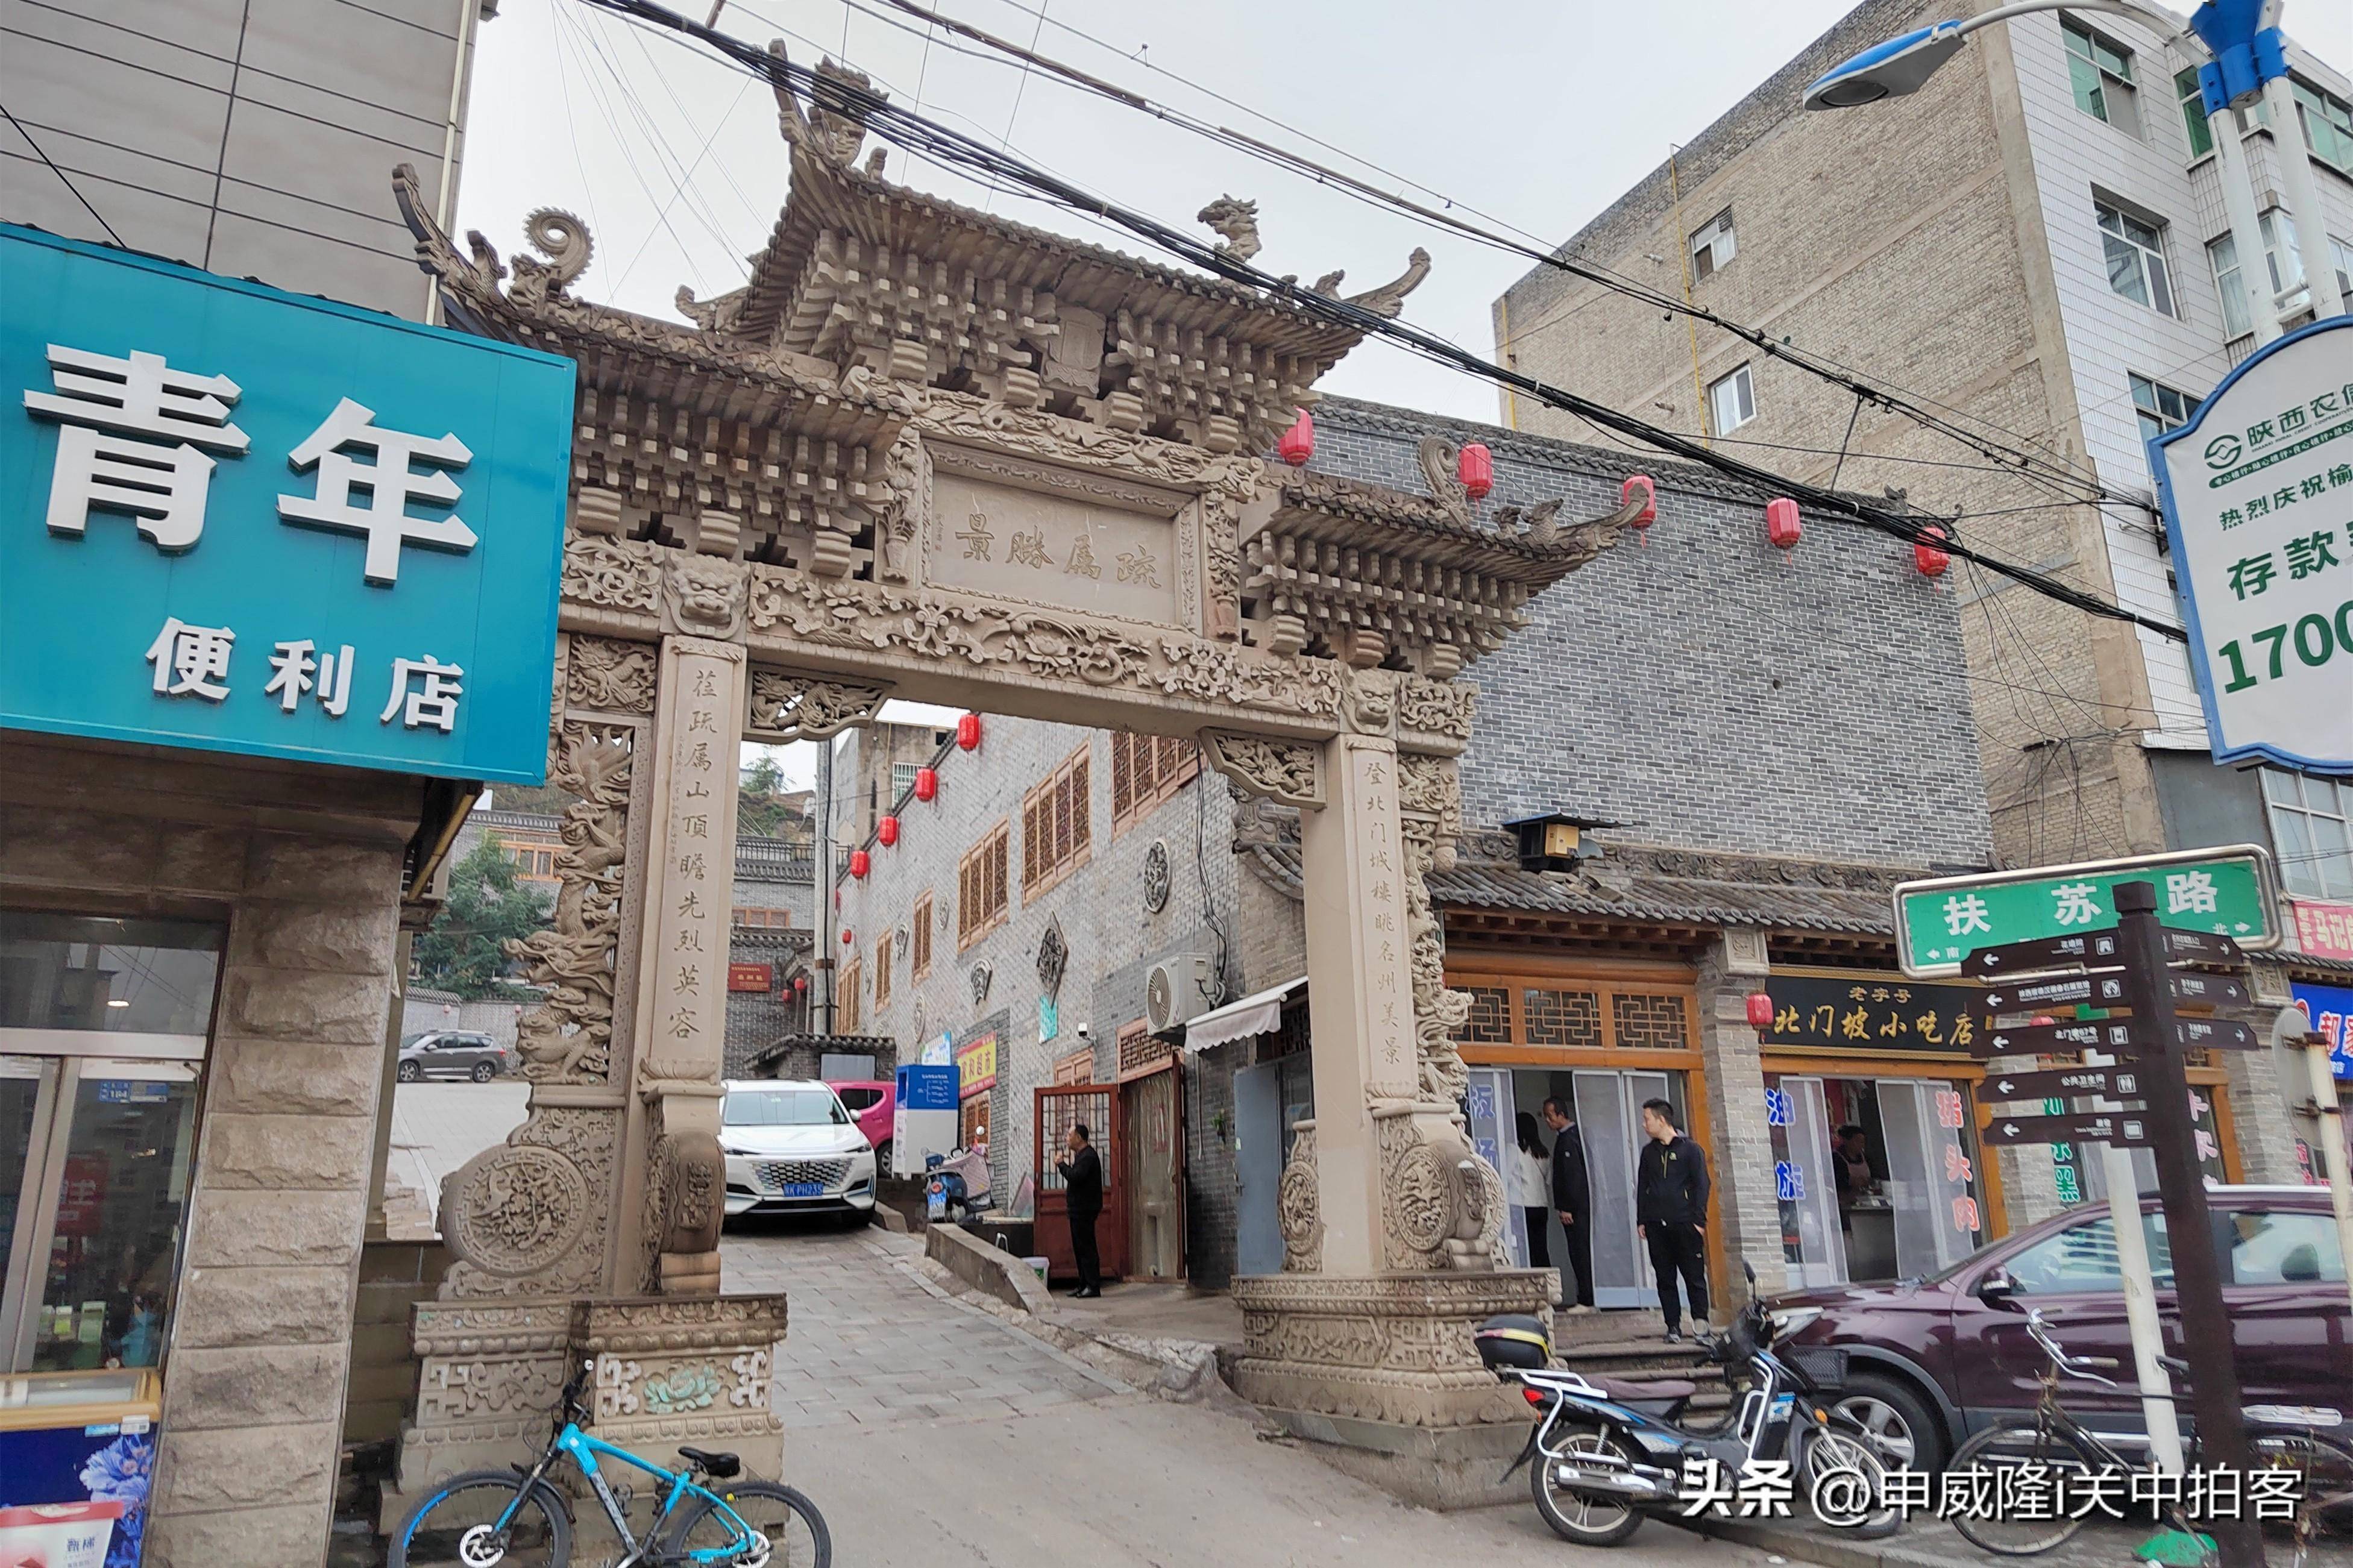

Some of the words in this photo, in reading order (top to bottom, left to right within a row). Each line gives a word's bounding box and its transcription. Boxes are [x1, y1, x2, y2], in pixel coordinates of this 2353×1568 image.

[23, 343, 479, 585] 青年
[2226, 521, 2353, 601] 存款
[145, 616, 464, 731] 便利店
[1943, 870, 2218, 936] 扶苏路
[2212, 923, 2229, 934] 北
[2313, 909, 2353, 951] 马记
[1945, 946, 1959, 959] 南
[1849, 985, 1912, 1003] 老字号
[1773, 1003, 1974, 1047] 北门坡小吃店
[1935, 1090, 1981, 1233] 猪头肉
